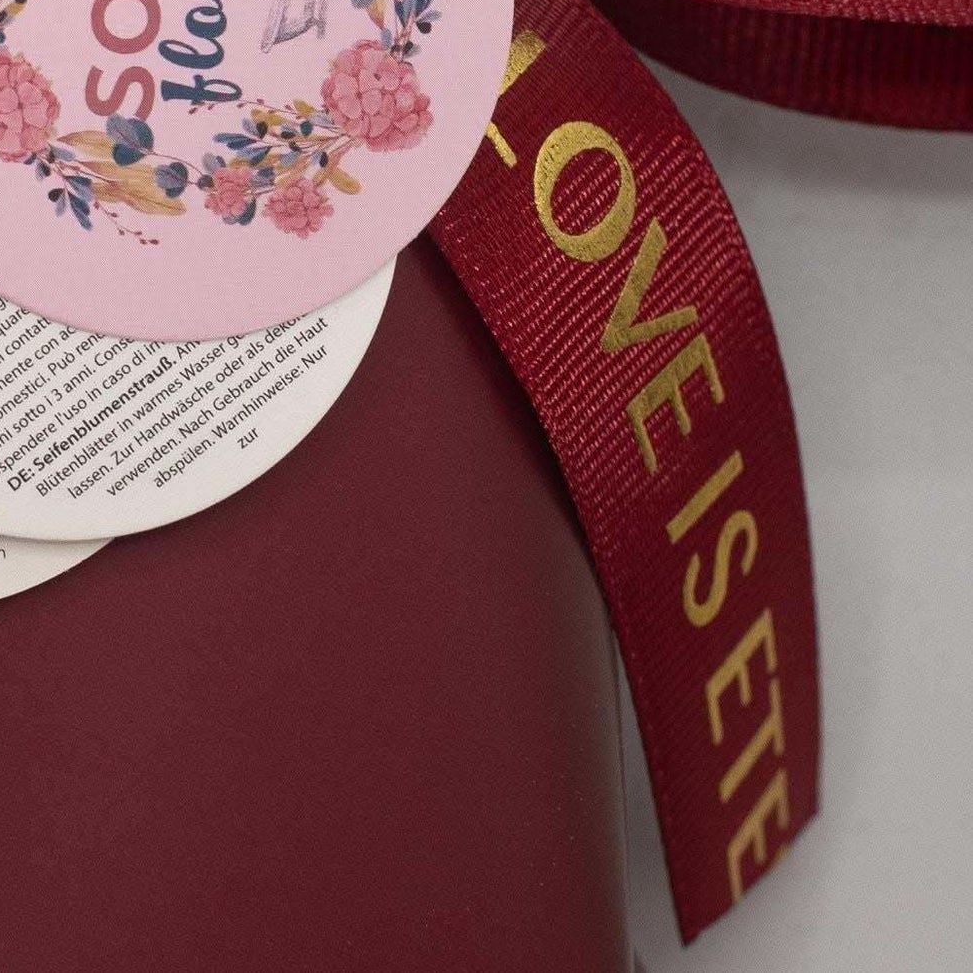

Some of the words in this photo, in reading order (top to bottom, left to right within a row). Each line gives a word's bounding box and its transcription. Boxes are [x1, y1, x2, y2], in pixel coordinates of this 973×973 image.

[12, 403, 47, 434] sotto
[50, 387, 64, 403] 3
[62, 363, 97, 394] anni.
[33, 337, 60, 361] con
[46, 351, 76, 377] Può
[53, 398, 88, 427] l'uso
[84, 387, 103, 403] in
[101, 363, 132, 391] caso
[131, 349, 147, 367] di
[105, 437, 182, 497] verwenden.
[177, 408, 215, 440] Nach
[212, 360, 276, 412] Gebrauch
[274, 343, 297, 365] die
[292, 316, 329, 348] Haut
[152, 438, 217, 489] abspülen.
[210, 364, 305, 439] Warnhinweise:
[300, 344, 328, 370] Nur
[6, 467, 36, 493] DE:
[32, 355, 178, 472] Seifenblumenstrauß.
[34, 427, 119, 498] Blütenblätter
[116, 417, 135, 433] in
[131, 377, 184, 421] warmes
[178, 342, 227, 382] Wasser
[66, 464, 114, 500] lassen.
[109, 442, 136, 467] Zur
[132, 380, 216, 448] Handwäsche
[214, 354, 246, 384] oder
[244, 340, 266, 360] als
[236, 427, 260, 450] zur
[666, 450, 758, 627] IS
[704, 607, 792, 902] ETE
